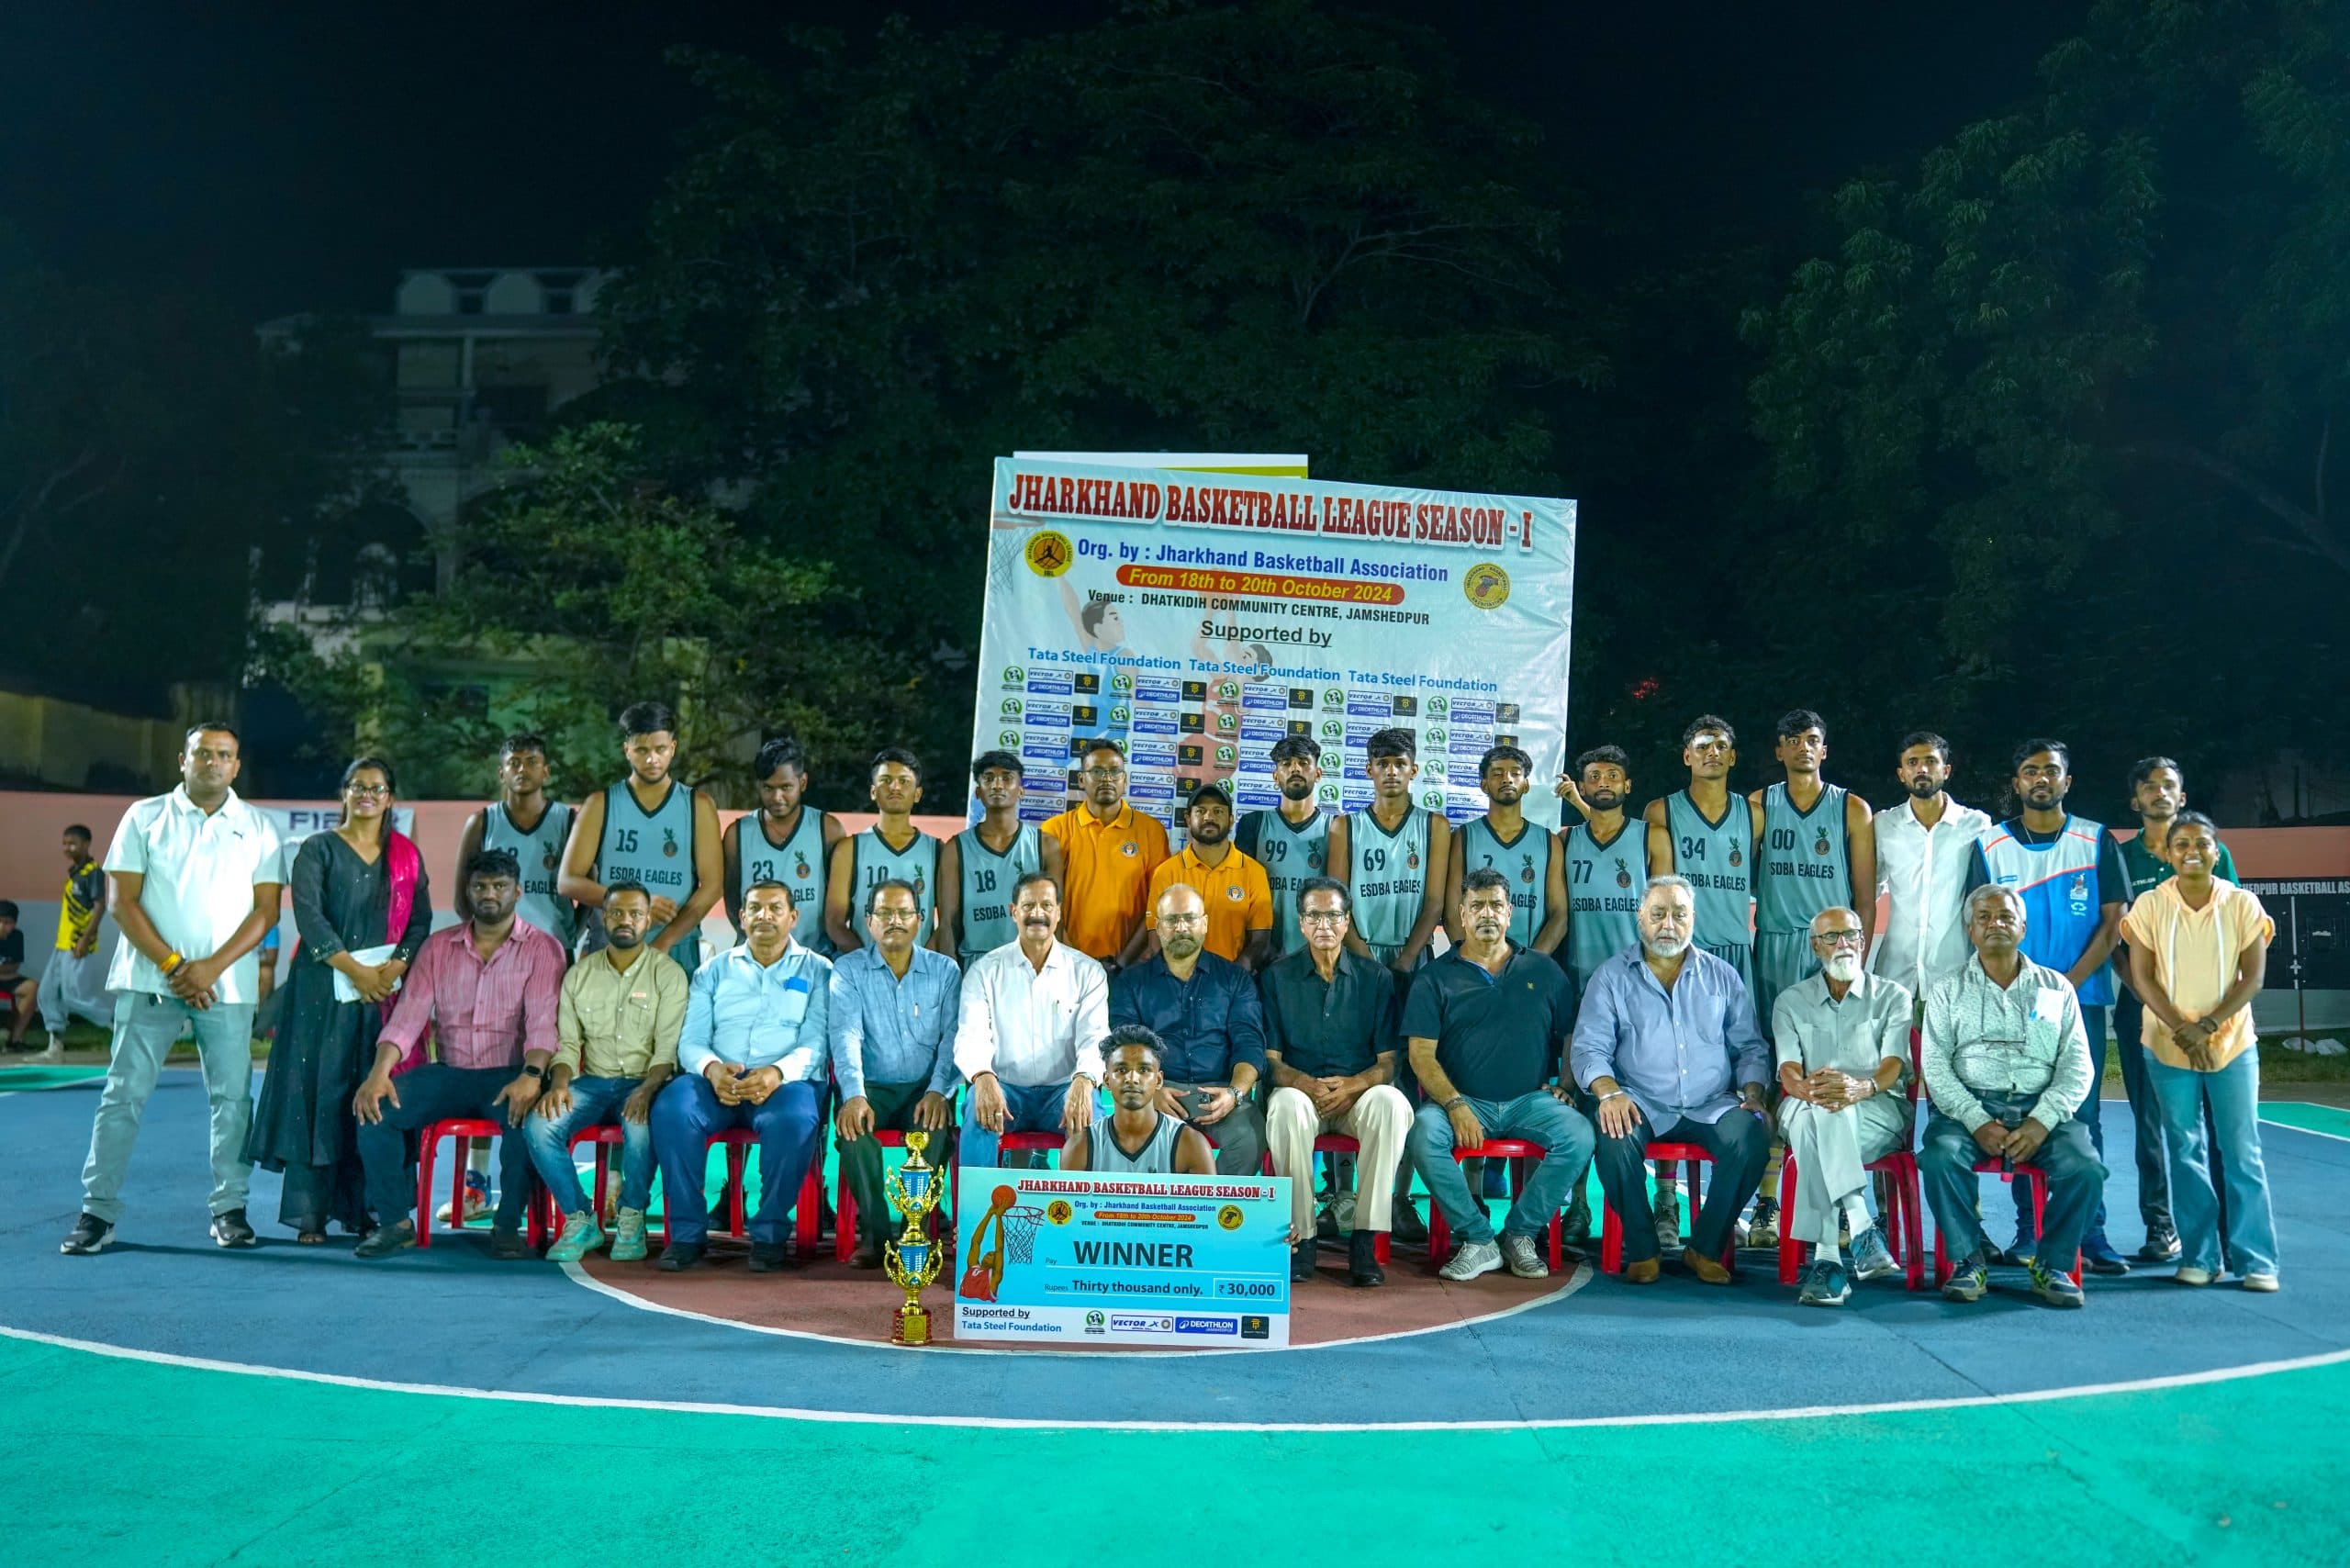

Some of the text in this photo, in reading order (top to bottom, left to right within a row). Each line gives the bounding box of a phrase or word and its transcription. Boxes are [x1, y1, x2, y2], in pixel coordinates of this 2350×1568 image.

[1009, 474, 1161, 520] JHARKHAND
[1165, 485, 1317, 532] BASKETBALL
[1322, 497, 1412, 539] LEAGUE
[1416, 504, 1505, 545] SEASON
[1521, 511, 1534, 548] I
[1078, 539, 1113, 560] Org.
[1119, 542, 1139, 563] by
[1156, 544, 1248, 566] Jharkhand
[1254, 551, 1345, 575] Basketball
[1349, 558, 1449, 582] Association
[1128, 568, 1393, 602] From 18th to 20th October 2024
[1088, 588, 1125, 603] Venue
[1141, 593, 1206, 610] DHATKIDIH
[1211, 597, 1287, 614] COMMUNITY
[1291, 603, 1343, 621] CENTRE,
[1346, 608, 1430, 625] JAMSHEDPUR
[1201, 620, 1333, 647] Supported by
[1028, 647, 1497, 691] Tata Steel Foundation Tata Steel Foundation Tata Steel Foundation
[615, 829, 639, 853] 15
[1771, 828, 1796, 851] 00
[1265, 839, 1288, 862] 99
[1681, 836, 1706, 861] 34
[1363, 847, 1386, 872] 69
[644, 869, 683, 886] EAGLES
[752, 859, 774, 883] 23
[1572, 859, 1594, 884] 77
[1768, 862, 1835, 879] SDBA EAGLES
[974, 868, 997, 893] 18
[1270, 877, 1288, 890] DBA
[1713, 875, 1746, 891] EAGLES
[2279, 881, 2336, 895] BASKETBALL
[791, 888, 816, 902] GLES
[1360, 884, 1391, 898] ESDBA
[1510, 893, 1538, 910] AGLES
[1606, 897, 1639, 913] EAGLES
[973, 906, 1007, 923] ESDBA
[1017, 1180, 1091, 1193] JHARKHAND
[1093, 1182, 1168, 1195] BASKETBALL
[1169, 1184, 1214, 1197] LEAGUE
[1215, 1186, 1260, 1198] SEASON
[1074, 1200, 1089, 1210] Org.
[1090, 1201, 1098, 1210] by
[1103, 1201, 1139, 1210] Jharkhand
[1141, 1203, 1177, 1211] Basketball
[1178, 1204, 1216, 1212] Association
[1151, 1214, 1177, 1222] October
[1045, 1256, 1058, 1266] Pay
[1073, 1240, 1194, 1269] WINNER
[1045, 1280, 1203, 1297] Rupees Thirty thousand only.
[1226, 1282, 1276, 1297] 30,000
[961, 1306, 1031, 1319] Supported by
[961, 1320, 1062, 1333] Tata Steel Foundation
[1113, 1319, 1147, 1327] VECTOR
[1190, 1320, 1234, 1329] DECATHLON
